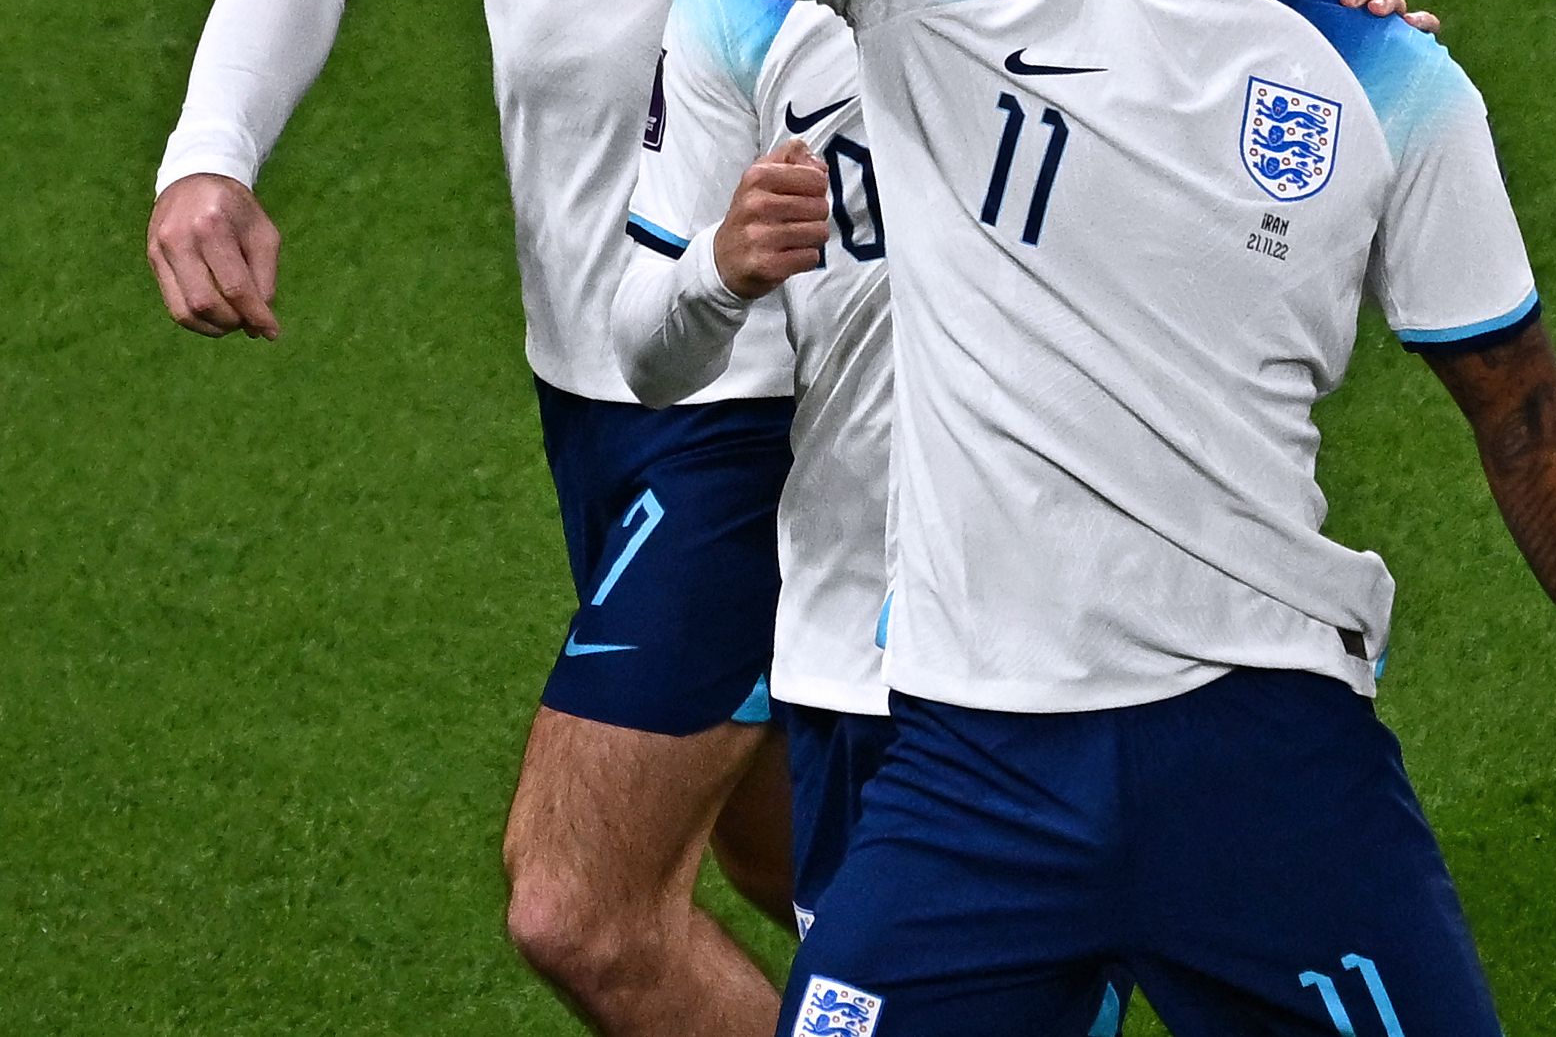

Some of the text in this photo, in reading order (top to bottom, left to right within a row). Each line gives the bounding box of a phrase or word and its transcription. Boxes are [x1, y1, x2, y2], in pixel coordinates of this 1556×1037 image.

[815, 133, 886, 269] 0
[979, 90, 1070, 247] 11
[1246, 233, 1289, 261] 21.11.22
[1261, 212, 1290, 237] IRAN
[591, 488, 665, 606] 7
[1298, 953, 1406, 1037] 11
